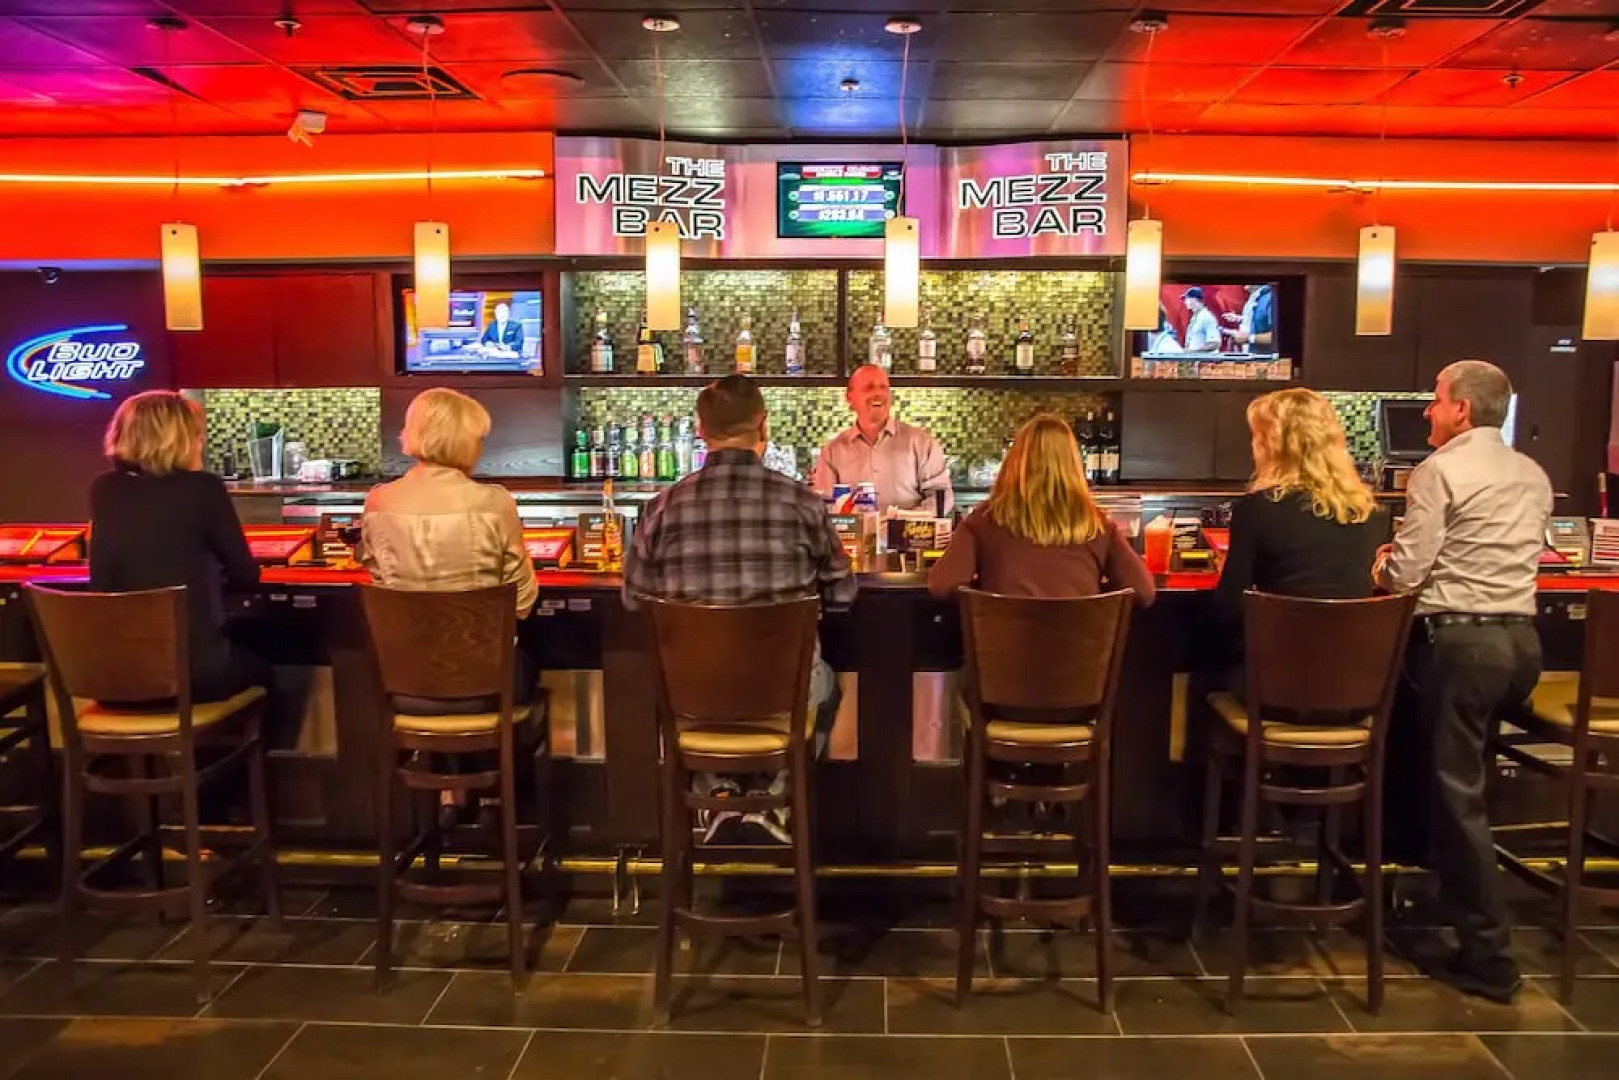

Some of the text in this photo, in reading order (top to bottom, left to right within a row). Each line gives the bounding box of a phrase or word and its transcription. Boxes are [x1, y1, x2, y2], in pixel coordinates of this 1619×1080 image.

[666, 157, 725, 177] THE
[1044, 152, 1107, 171] THE
[576, 174, 725, 208] MEZZ
[958, 173, 1106, 209] MEZZ
[992, 205, 1106, 239] BAR
[47, 342, 140, 362] BUD
[27, 360, 145, 382] LIGHT
